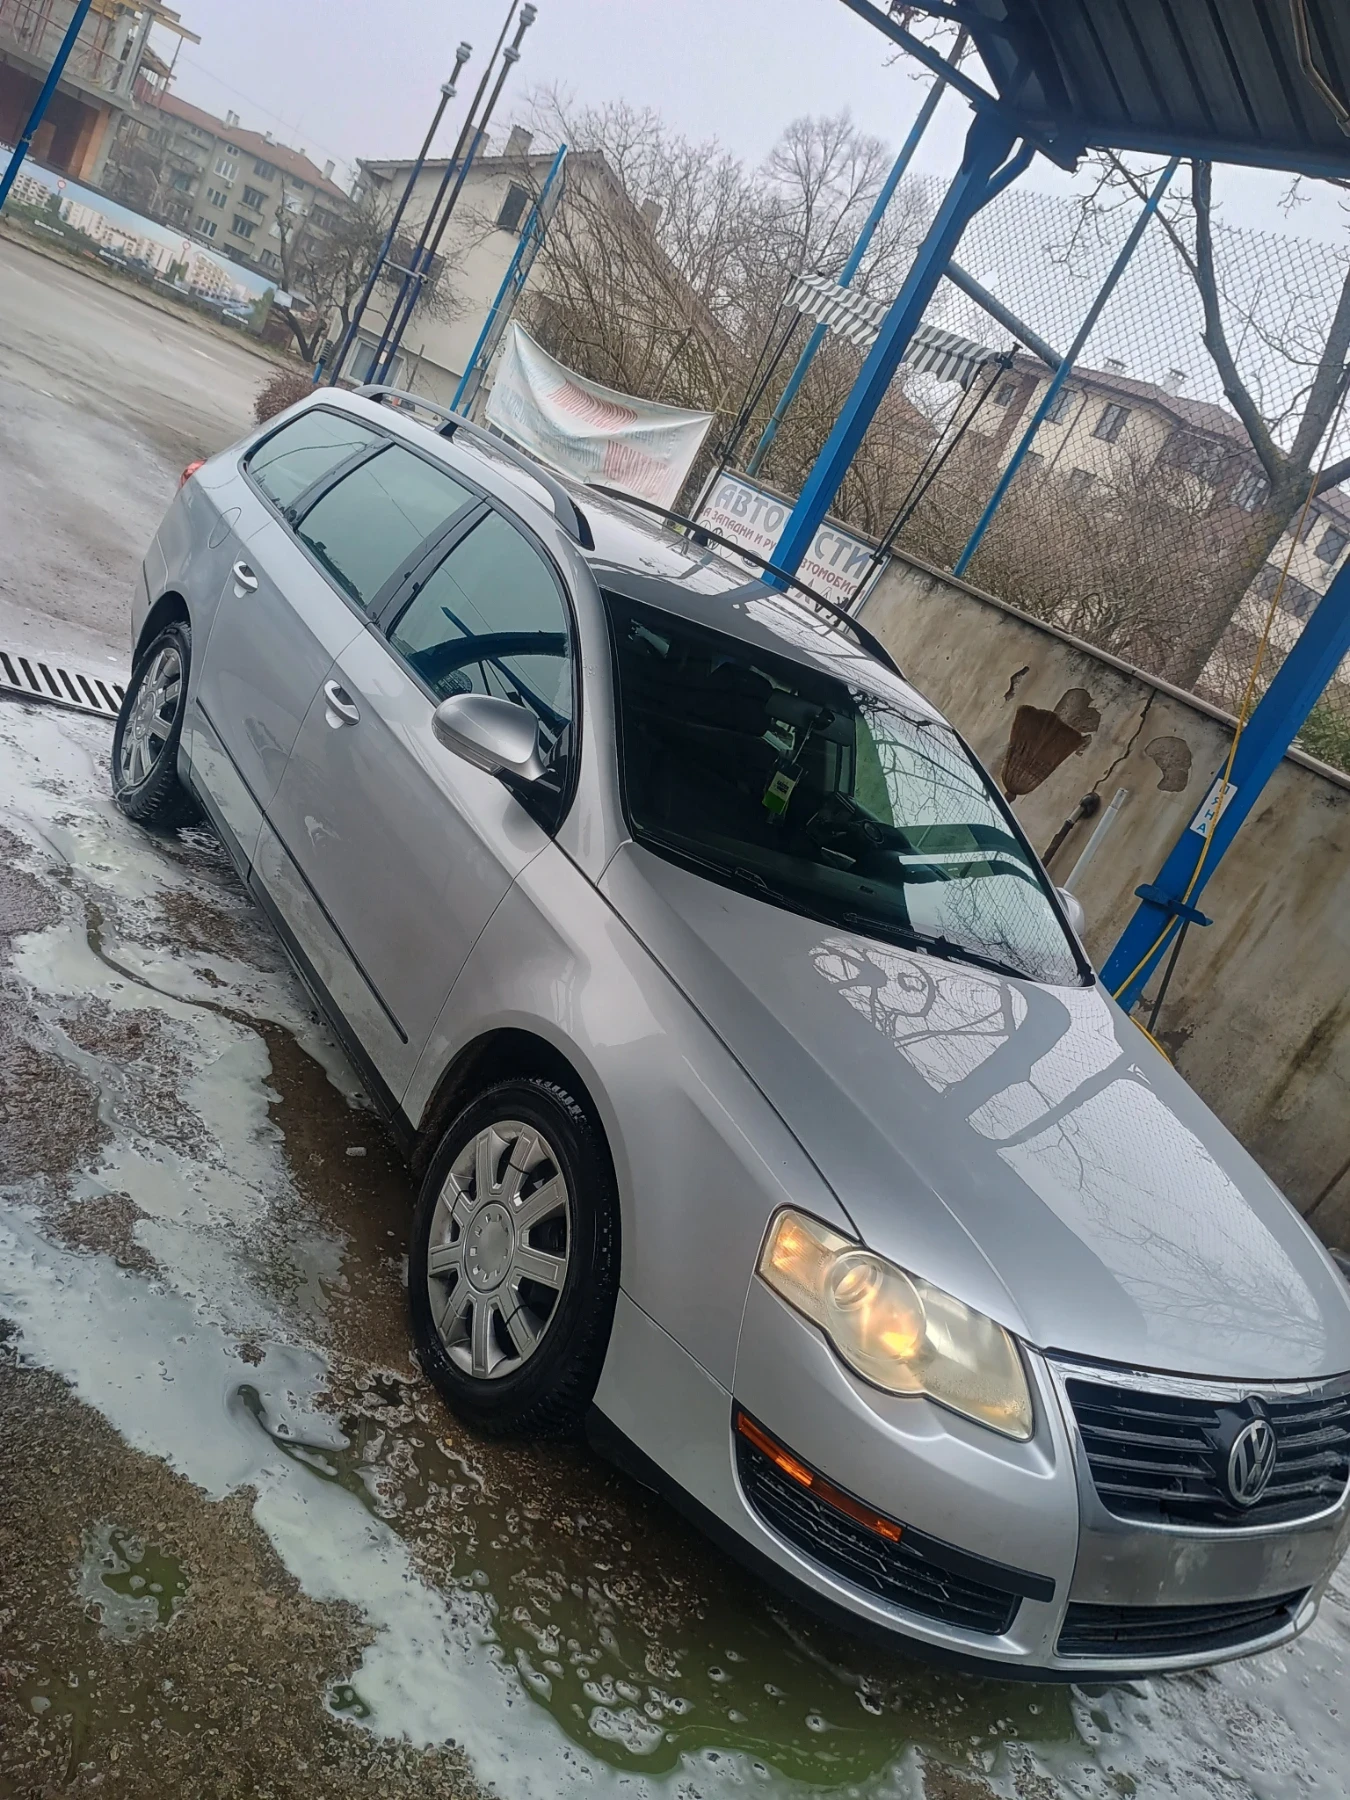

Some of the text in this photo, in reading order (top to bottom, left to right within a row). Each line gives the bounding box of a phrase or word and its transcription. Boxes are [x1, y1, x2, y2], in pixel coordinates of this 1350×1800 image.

[711, 510, 755, 540] ЗАПАДНИ
[753, 533, 764, 545] И
[799, 557, 866, 601] ВТОМОБИЛИ
[714, 484, 871, 580] АВТОСТИ
